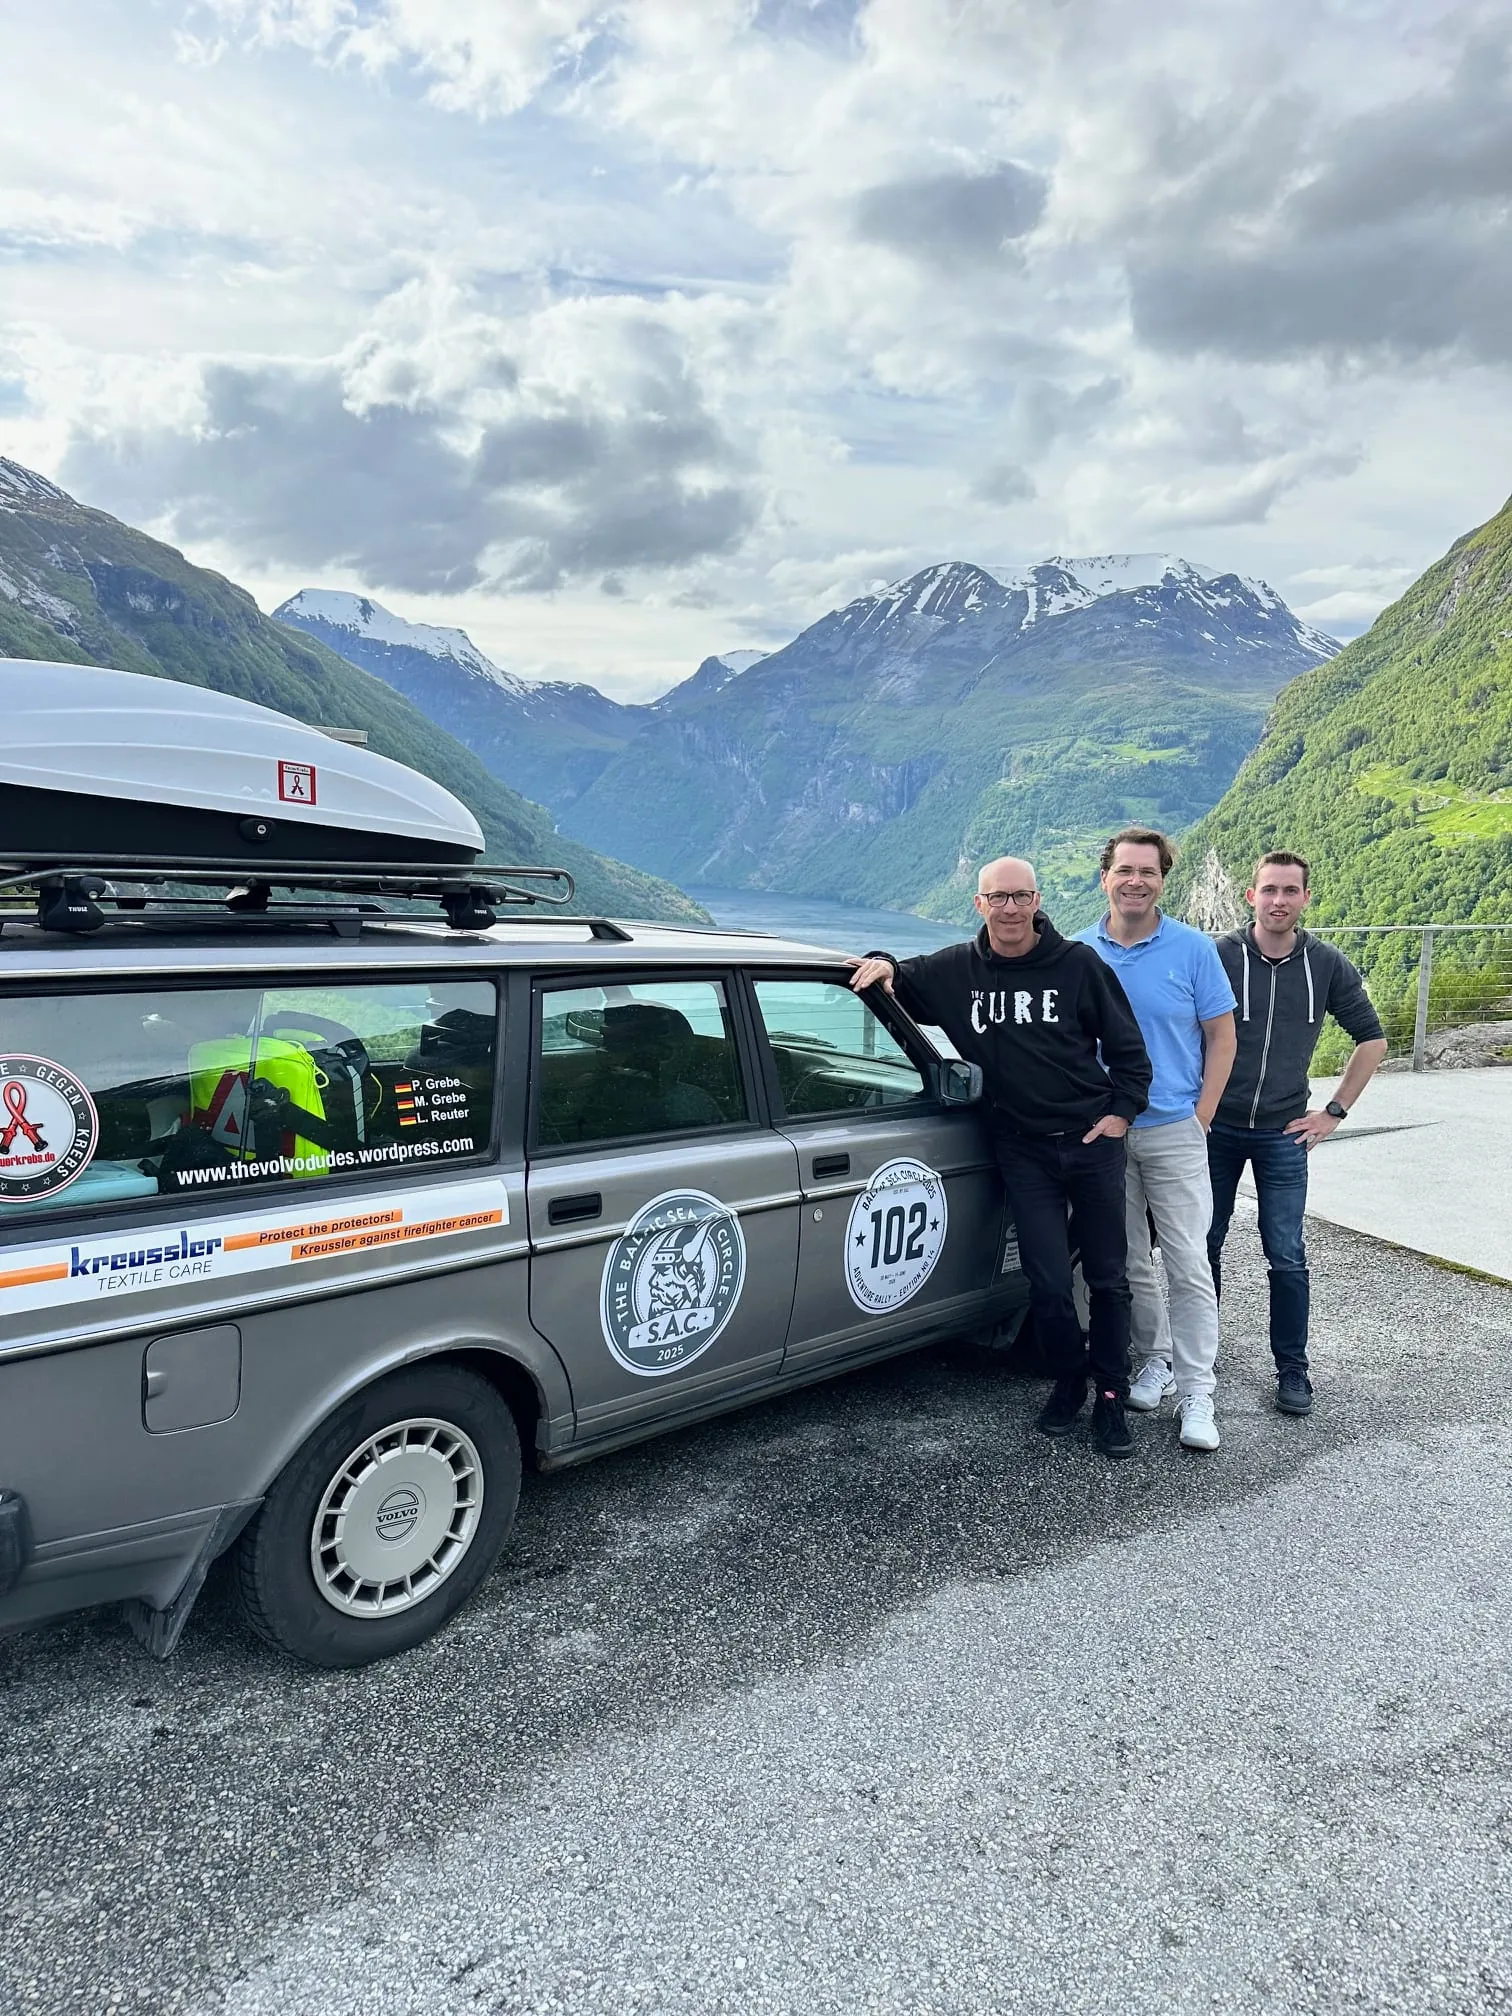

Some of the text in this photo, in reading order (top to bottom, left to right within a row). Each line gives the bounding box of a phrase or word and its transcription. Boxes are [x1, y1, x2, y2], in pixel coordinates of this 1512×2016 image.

[971, 990, 984, 999] THE
[971, 990, 1059, 1034] CURE
[412, 1077, 460, 1091] P. Grebe
[414, 1092, 466, 1108] M. Grebe
[416, 1108, 469, 1123] L. Reuter
[36, 1066, 90, 1178] GEGEN KREBS
[176, 1136, 474, 1185] www.thevolvodudes.wordpress.com
[886, 1172, 901, 1186] SEA
[259, 1212, 394, 1243] Protect the protectors!
[300, 1213, 493, 1255] Kreussler against firefighter cancer
[870, 1202, 928, 1269] 102
[71, 1231, 222, 1277] kreussler
[616, 1281, 629, 1323] THE
[666, 1207, 698, 1222] SEA
[716, 1228, 733, 1295] CIRCLE
[98, 1260, 213, 1291] TEXTILE CARE
[899, 1272, 921, 1297] EDITION
[648, 1312, 700, 1344] S.A.C.
[656, 1345, 684, 1361] 2025
[377, 1508, 418, 1522] VOLVO
